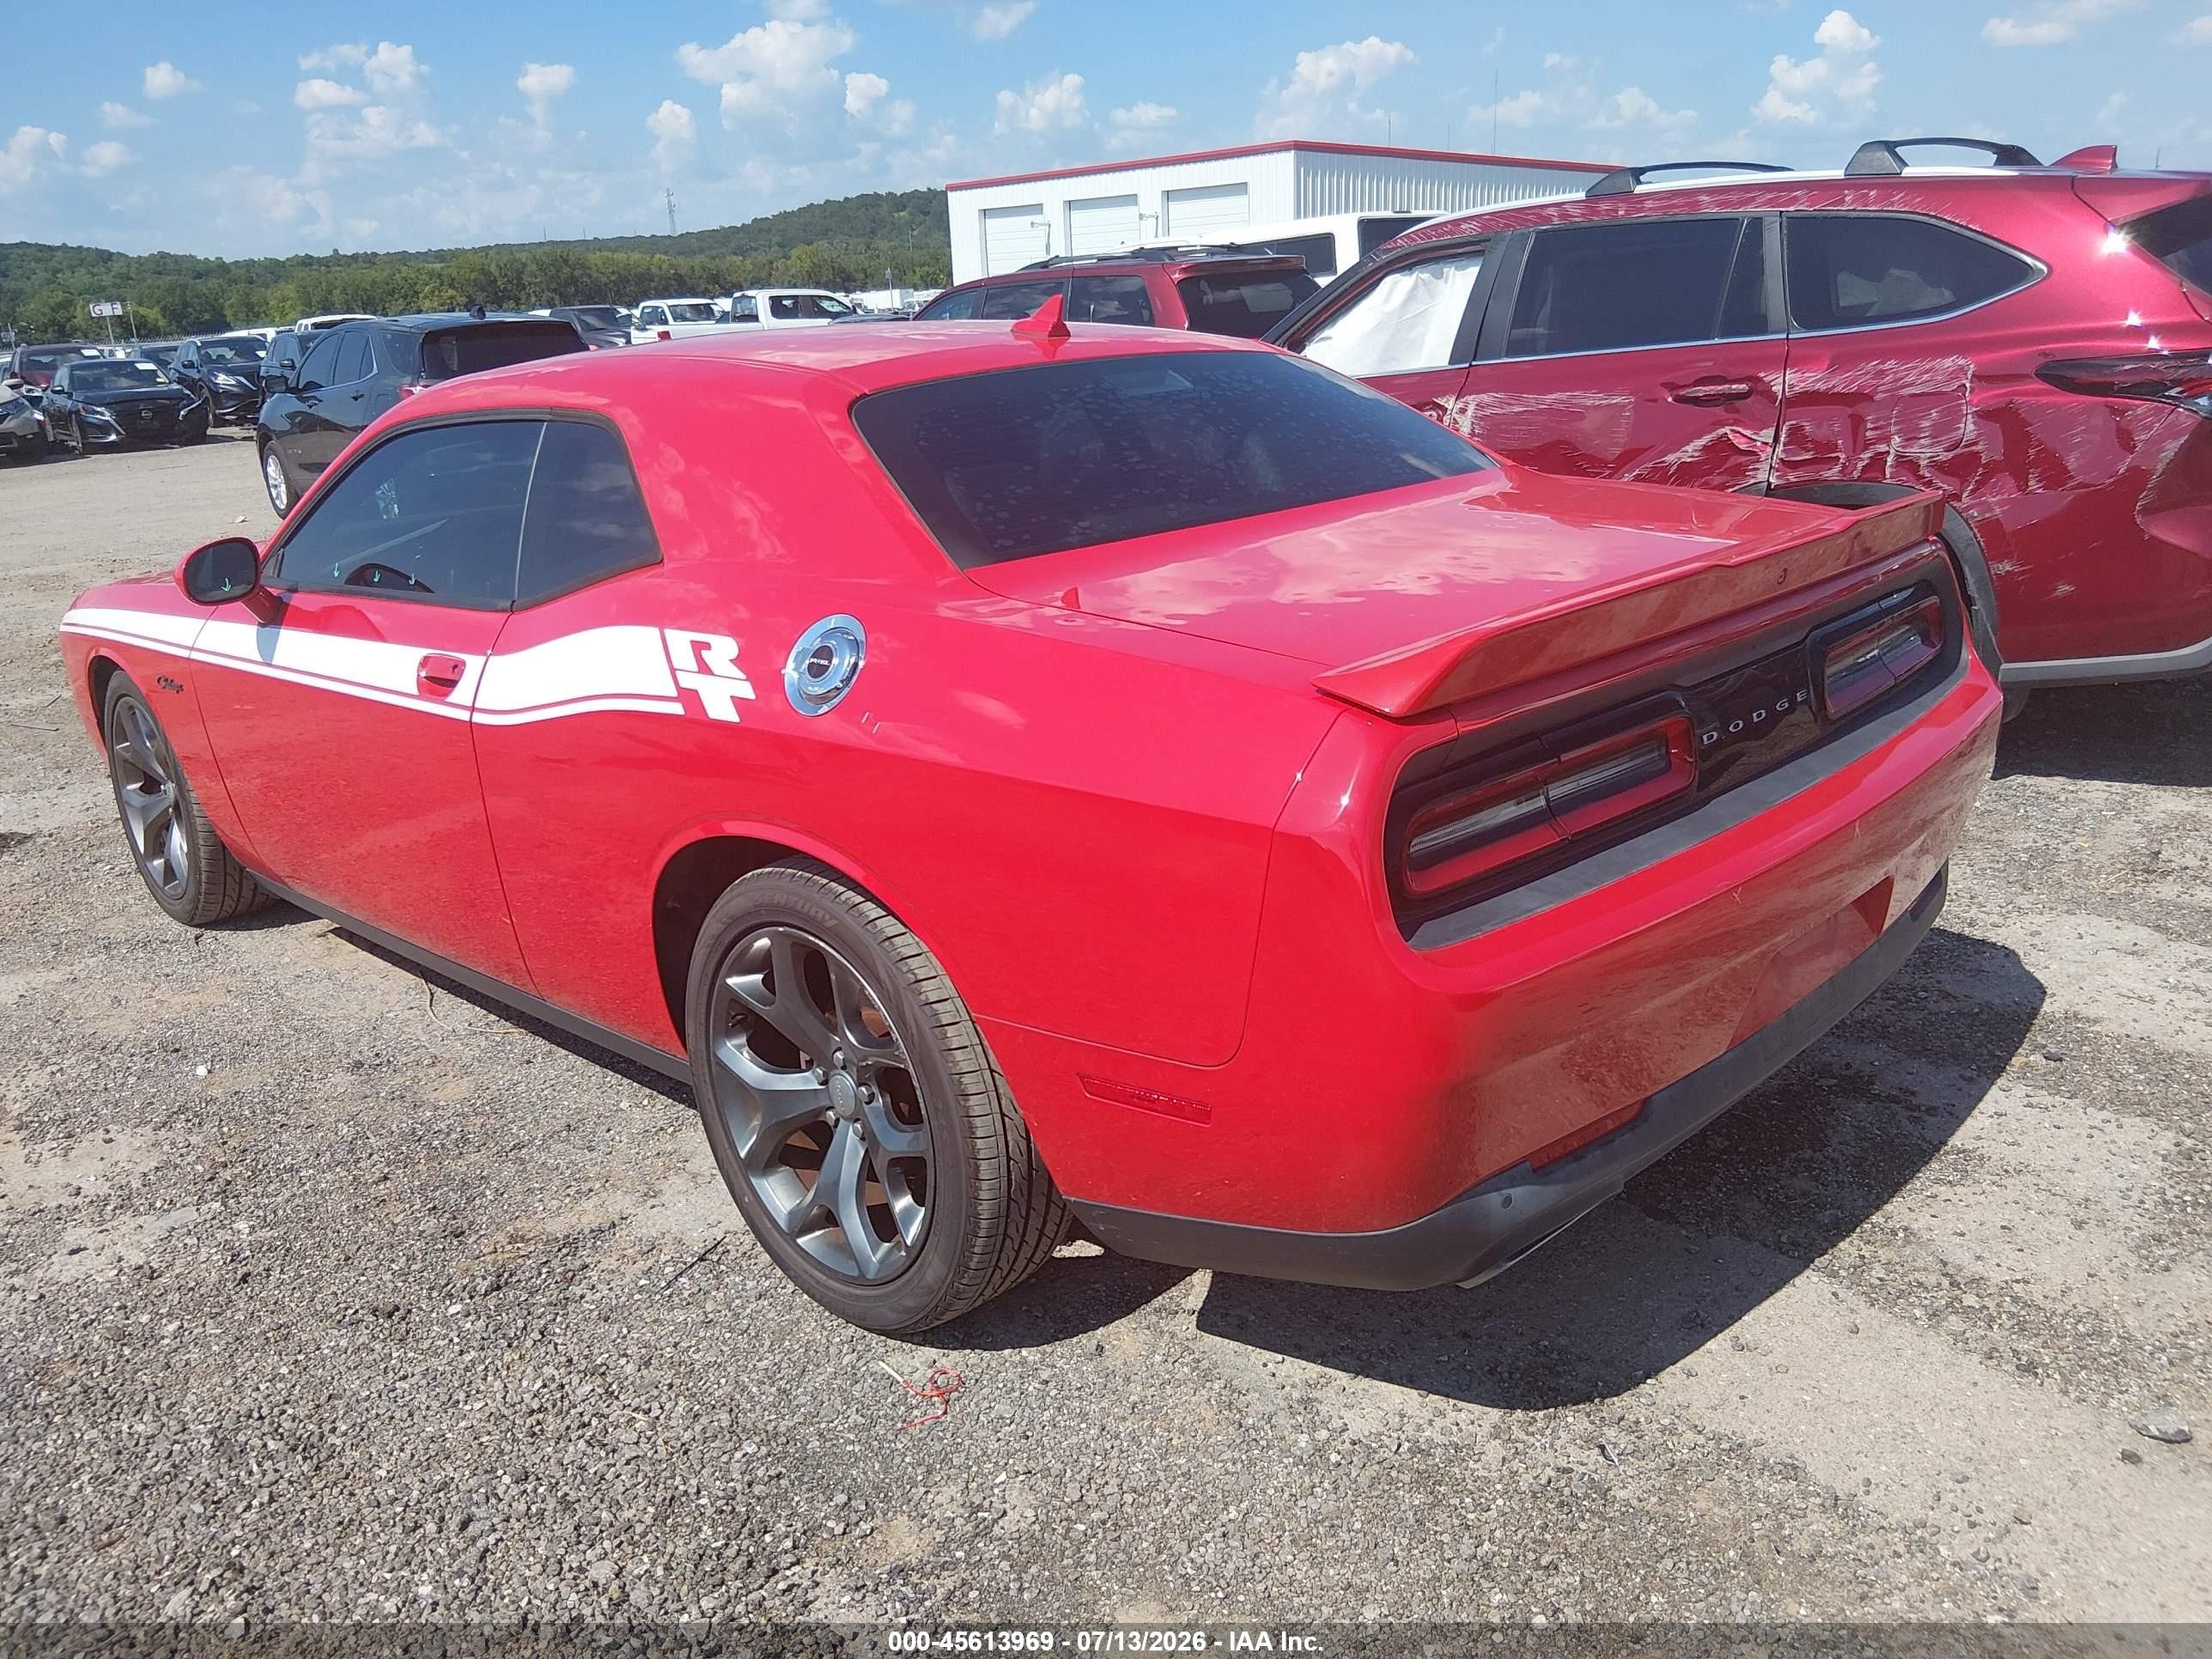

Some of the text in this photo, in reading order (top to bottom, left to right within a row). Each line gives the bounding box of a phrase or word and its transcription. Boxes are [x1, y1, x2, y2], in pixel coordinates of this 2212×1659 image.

[92, 302, 118, 316] G F
[1702, 689, 1808, 745] DODGE
